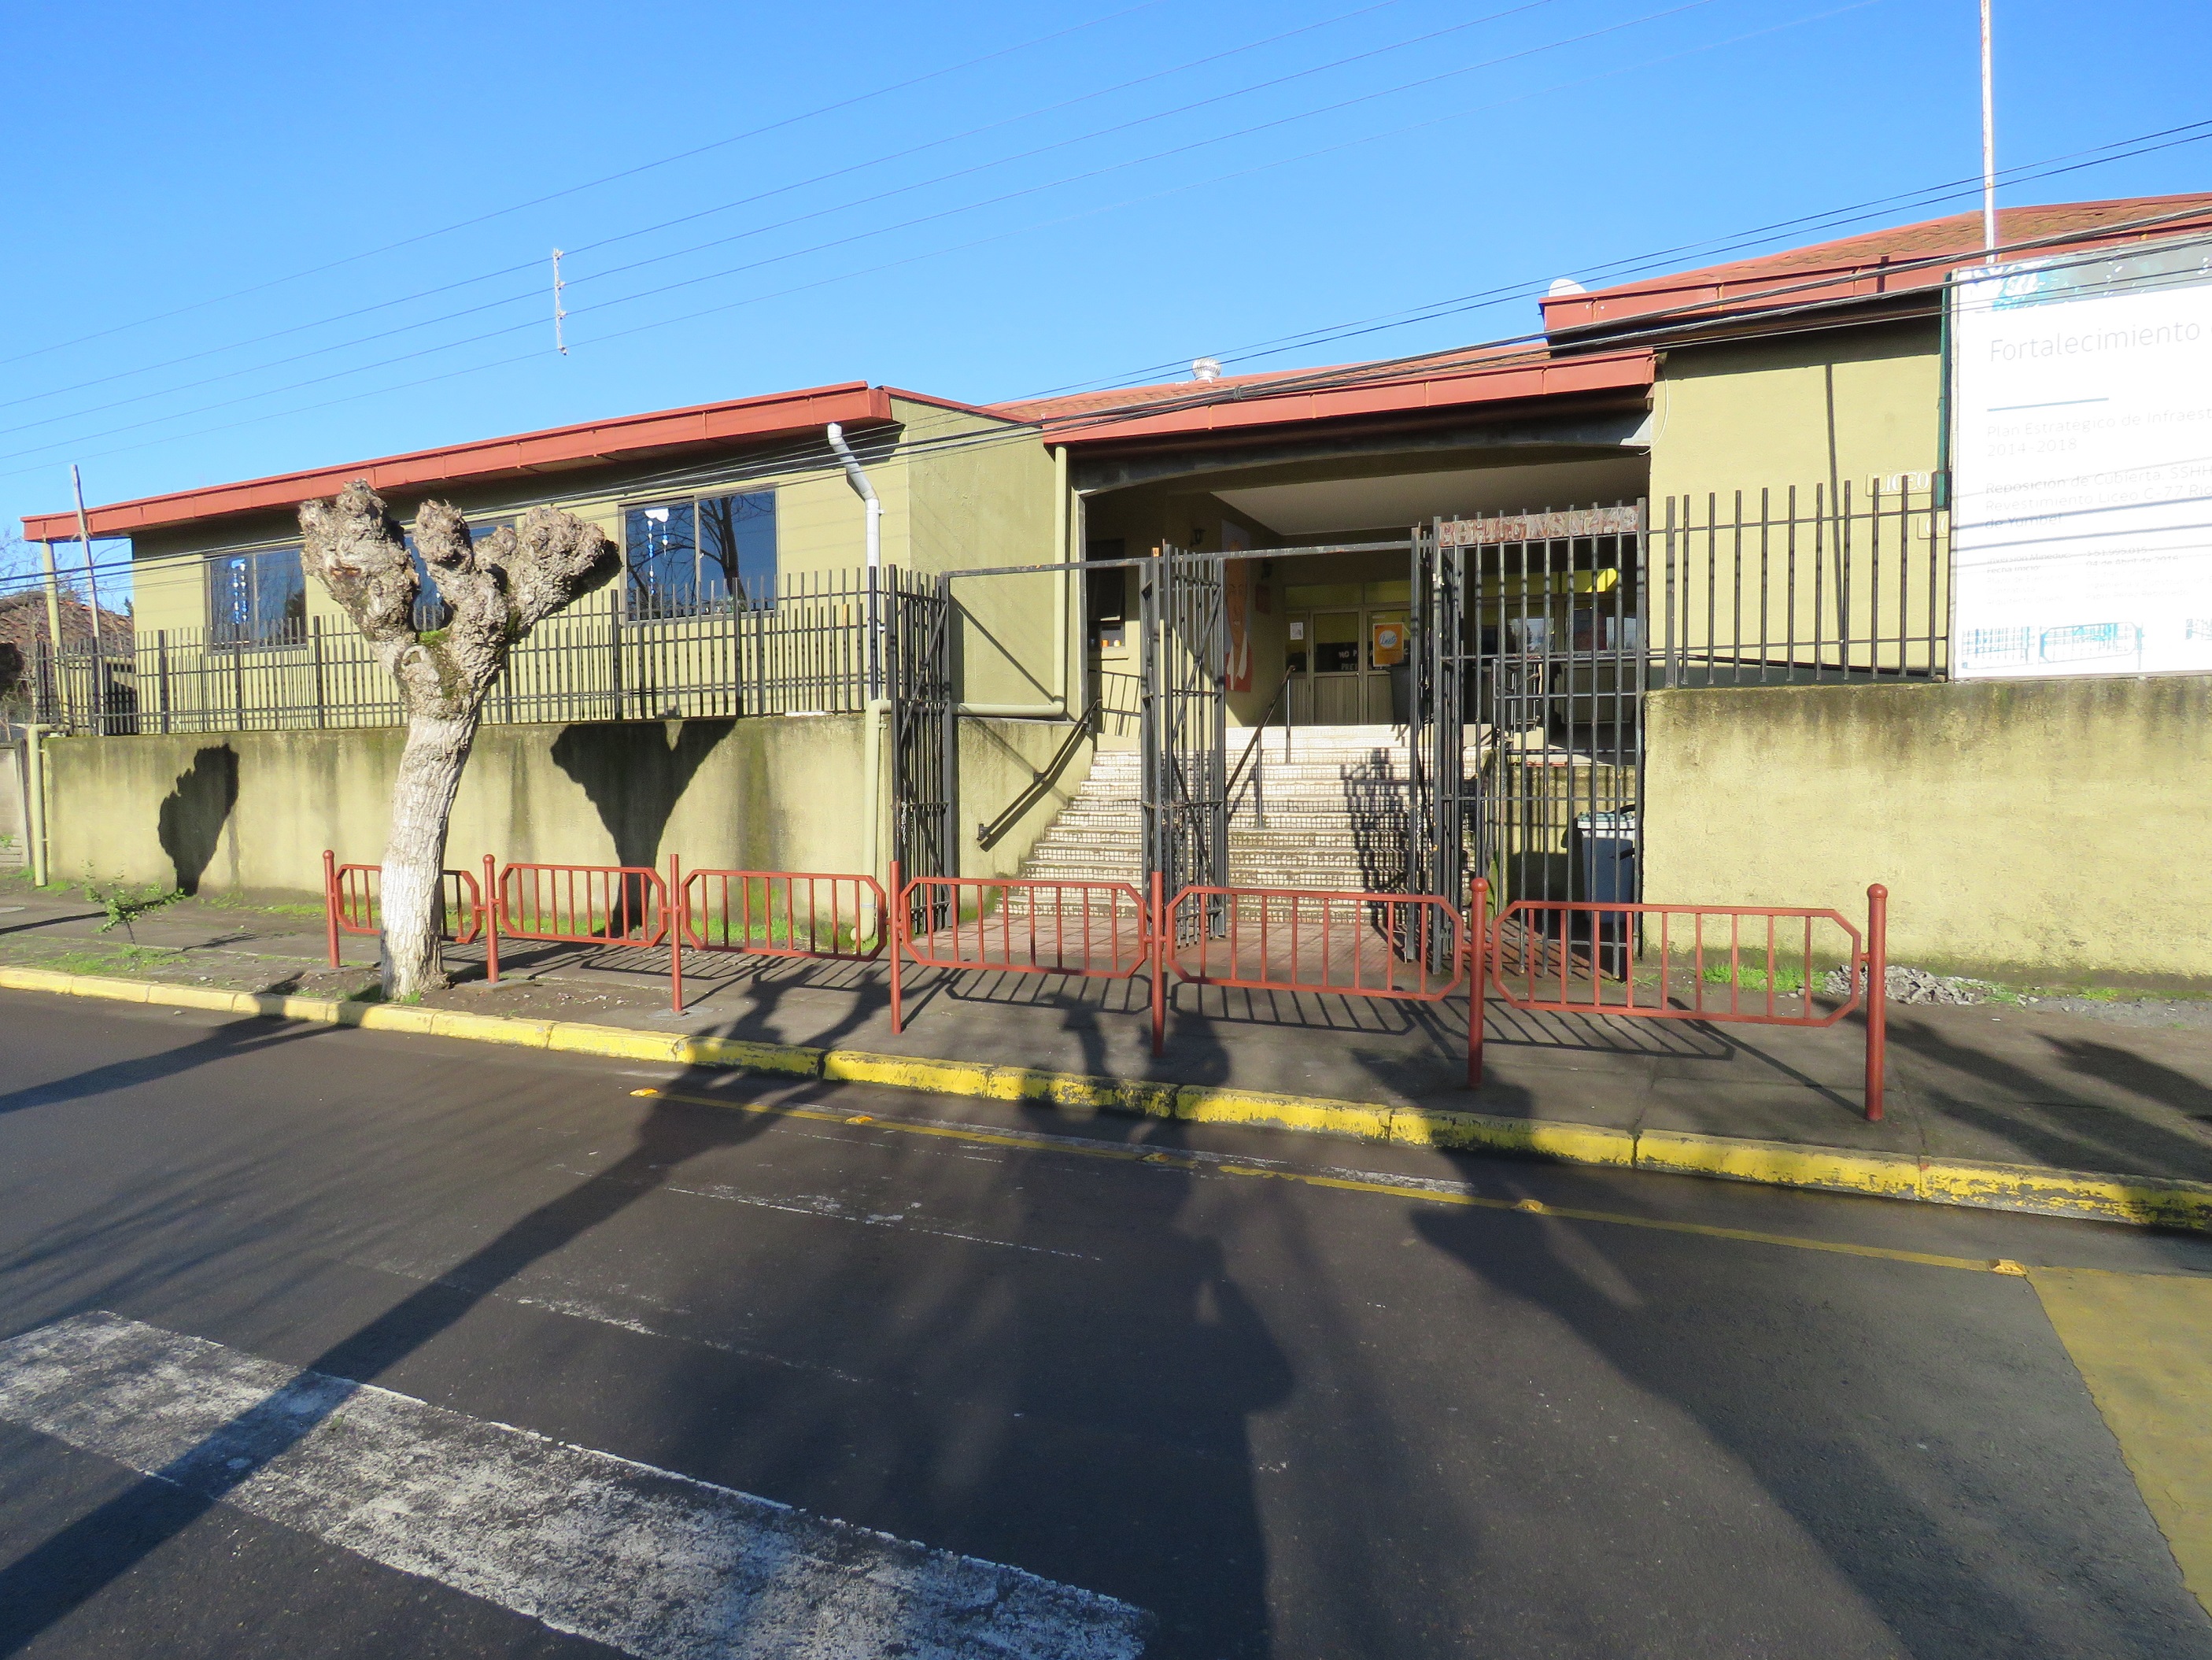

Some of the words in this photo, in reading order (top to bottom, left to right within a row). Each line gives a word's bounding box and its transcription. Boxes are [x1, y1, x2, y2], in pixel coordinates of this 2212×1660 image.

[1990, 322, 2201, 362] Fortalecimiento
[1987, 425, 2020, 438] Plan
[2122, 413, 2141, 427] de
[1987, 438, 2077, 457] 2014-2018
[2070, 475, 2089, 487] de
[1985, 496, 2092, 512] Revestimiento
[2099, 491, 2139, 504] Liceo
[2144, 485, 2184, 500] C-77
